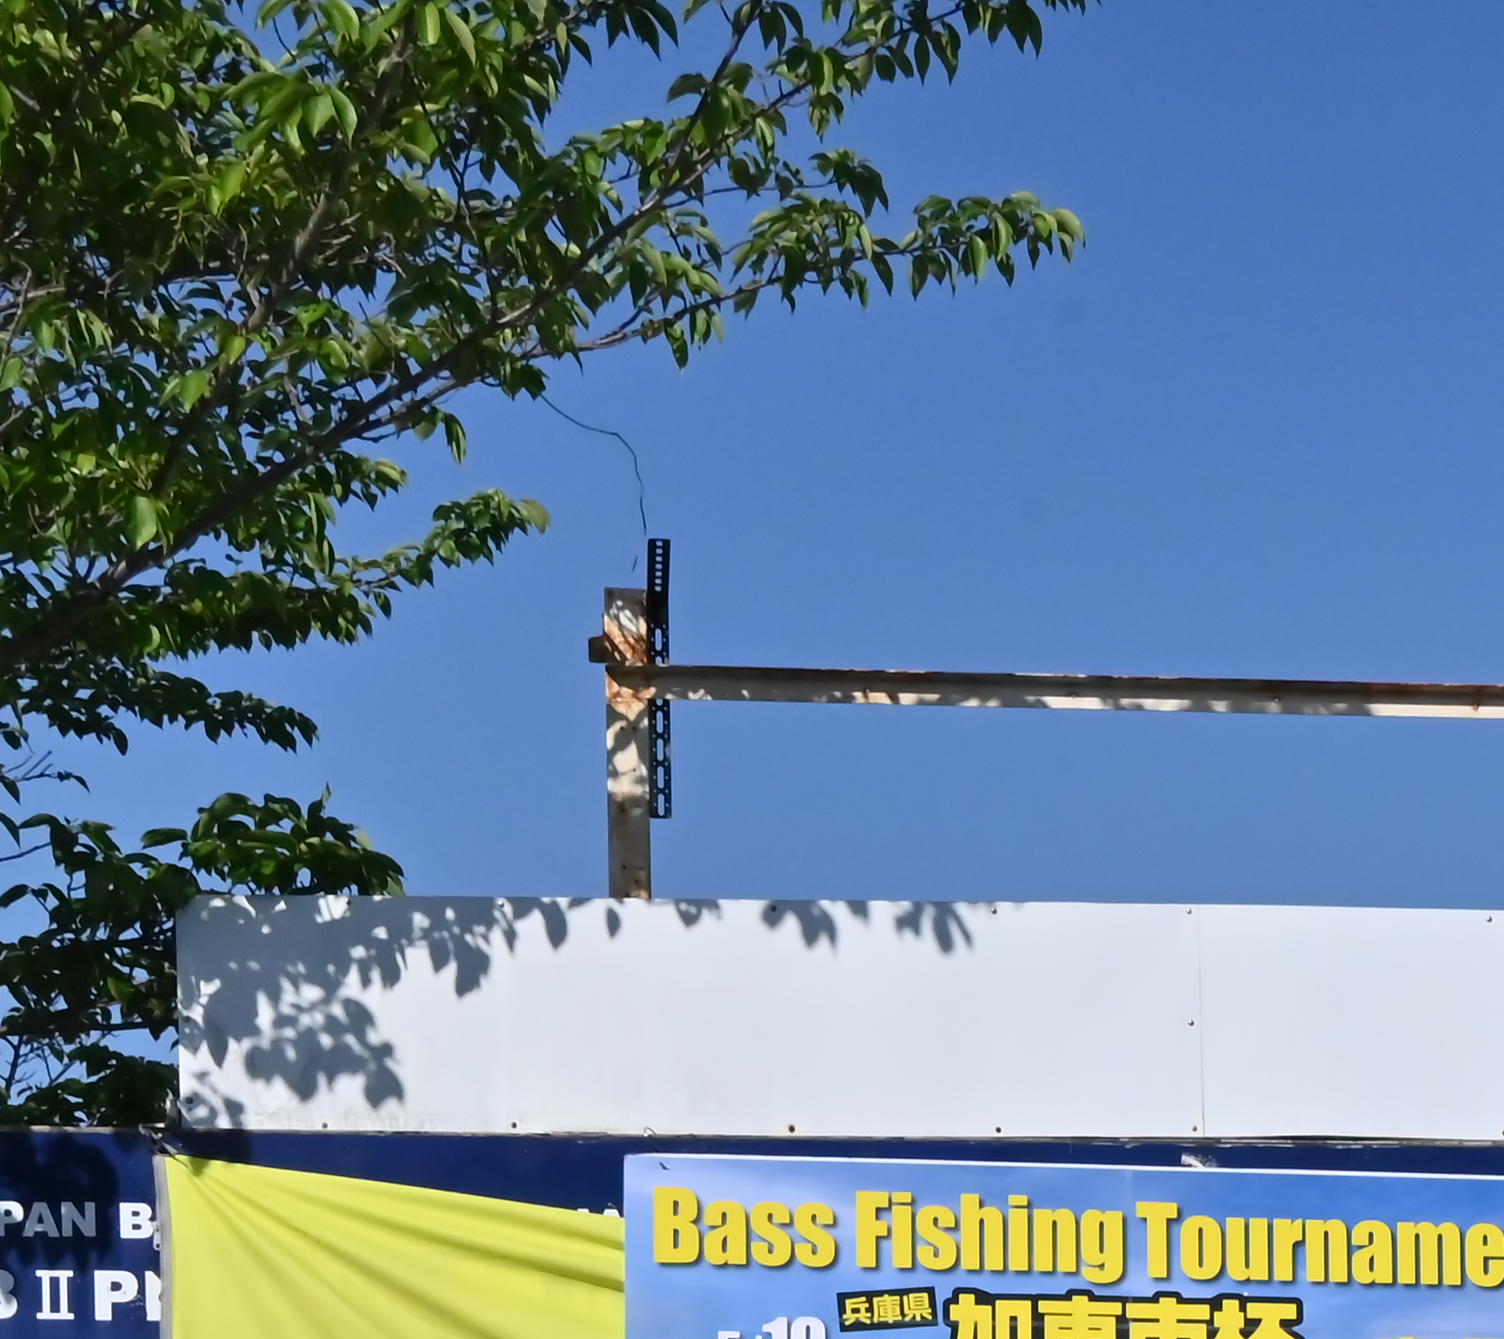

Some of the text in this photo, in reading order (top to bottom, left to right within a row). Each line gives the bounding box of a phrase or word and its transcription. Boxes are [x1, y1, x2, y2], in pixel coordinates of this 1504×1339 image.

[118, 1202, 156, 1239] B
[653, 1186, 836, 1268] Bass
[855, 1190, 1125, 1285] Fishing
[841, 1292, 933, 1327] 兵庫県
